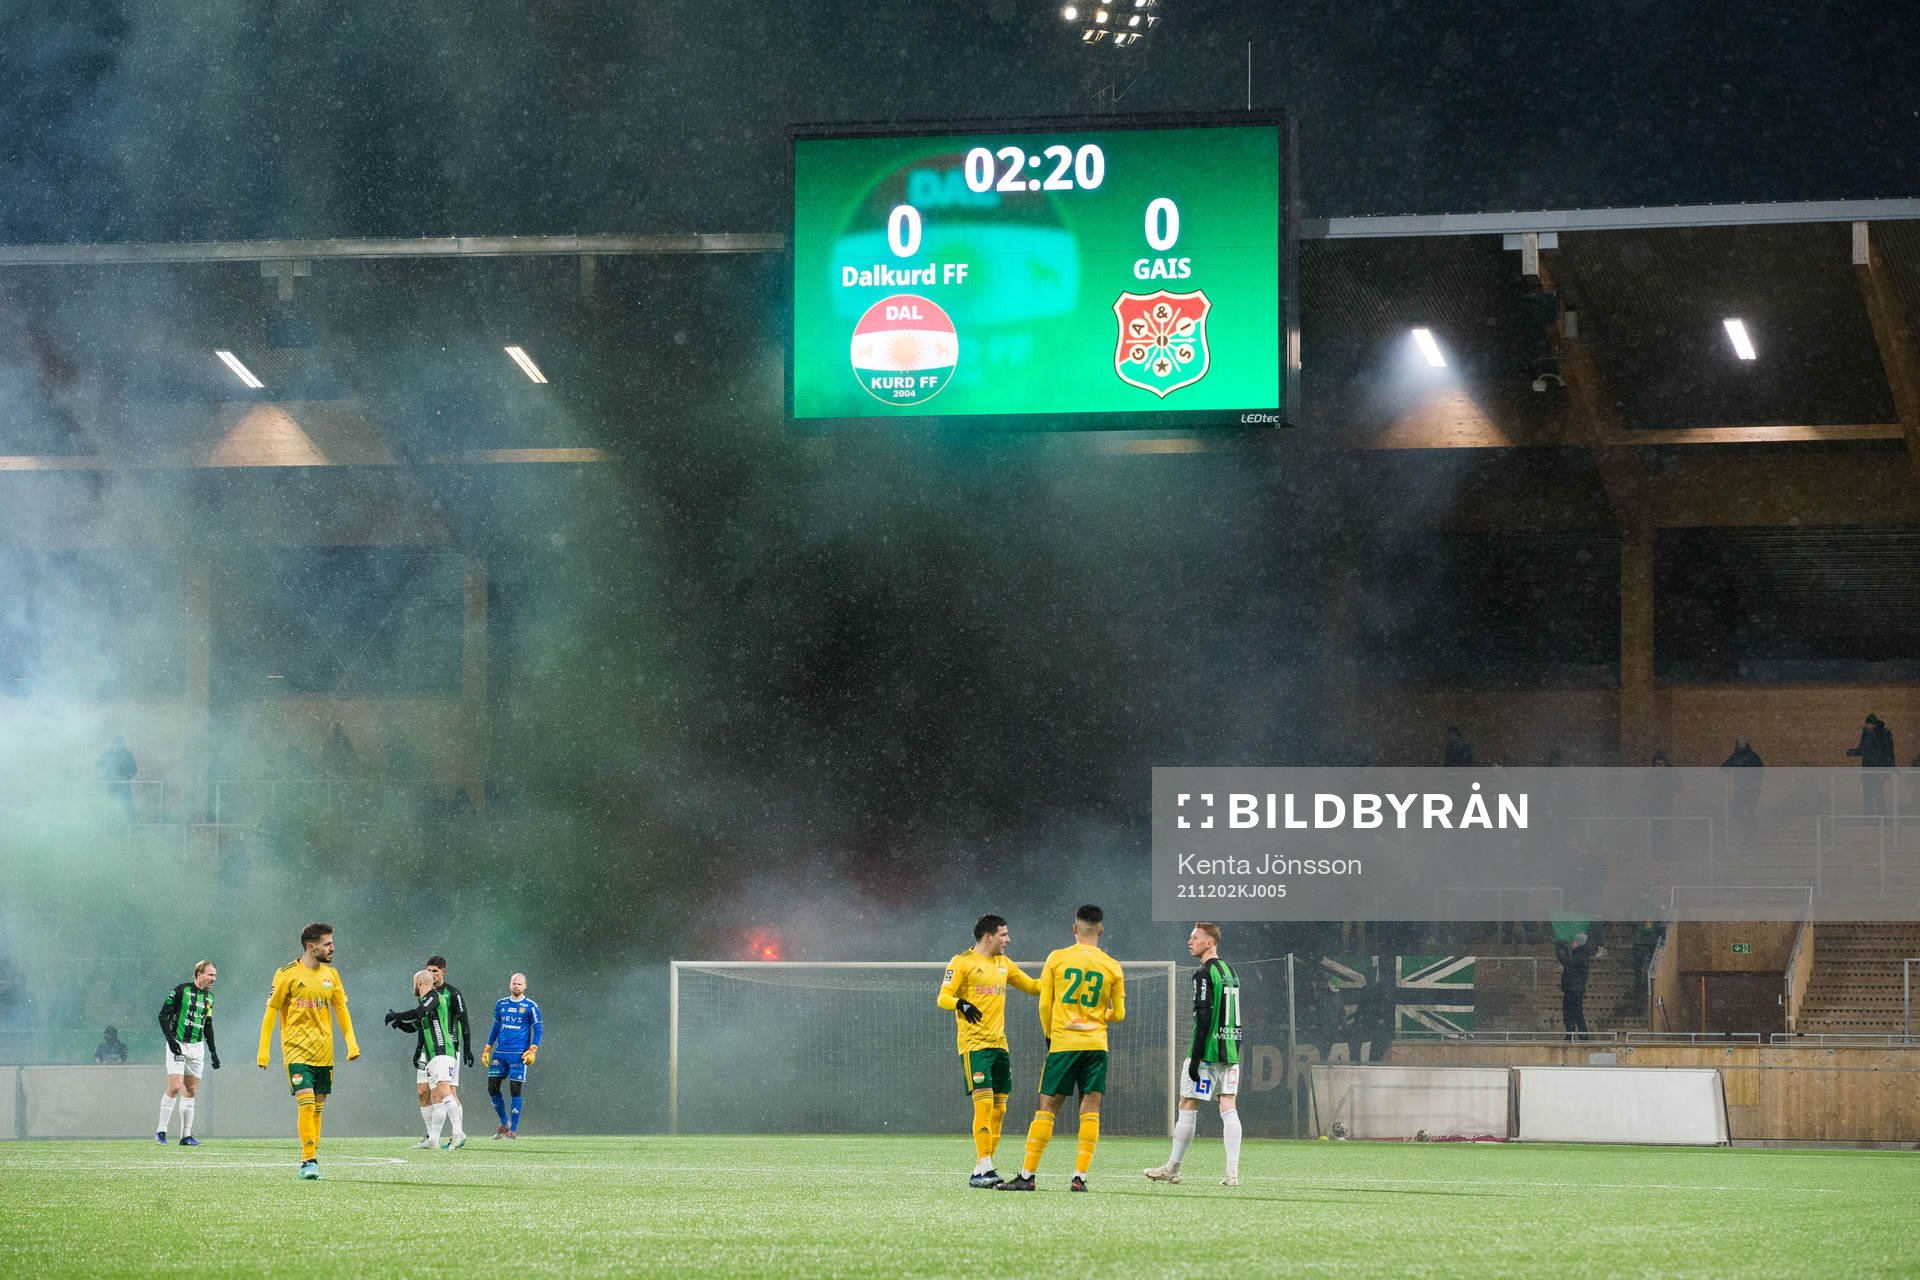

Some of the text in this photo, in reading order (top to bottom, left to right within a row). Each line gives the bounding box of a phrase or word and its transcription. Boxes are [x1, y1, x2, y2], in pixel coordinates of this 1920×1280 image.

[964, 144, 1106, 194] 02:20
[887, 204, 922, 258] 0
[1145, 197, 1180, 251] 0
[842, 263, 969, 287] Dalkurd FF
[1133, 257, 1191, 281] GAIS
[886, 305, 923, 320] DAL
[871, 376, 939, 389] KURD FF
[893, 390, 916, 398] 2004
[1241, 413, 1280, 424] LEDtec
[1062, 968, 1104, 1008] 23
[1223, 986, 1241, 1026] 11
